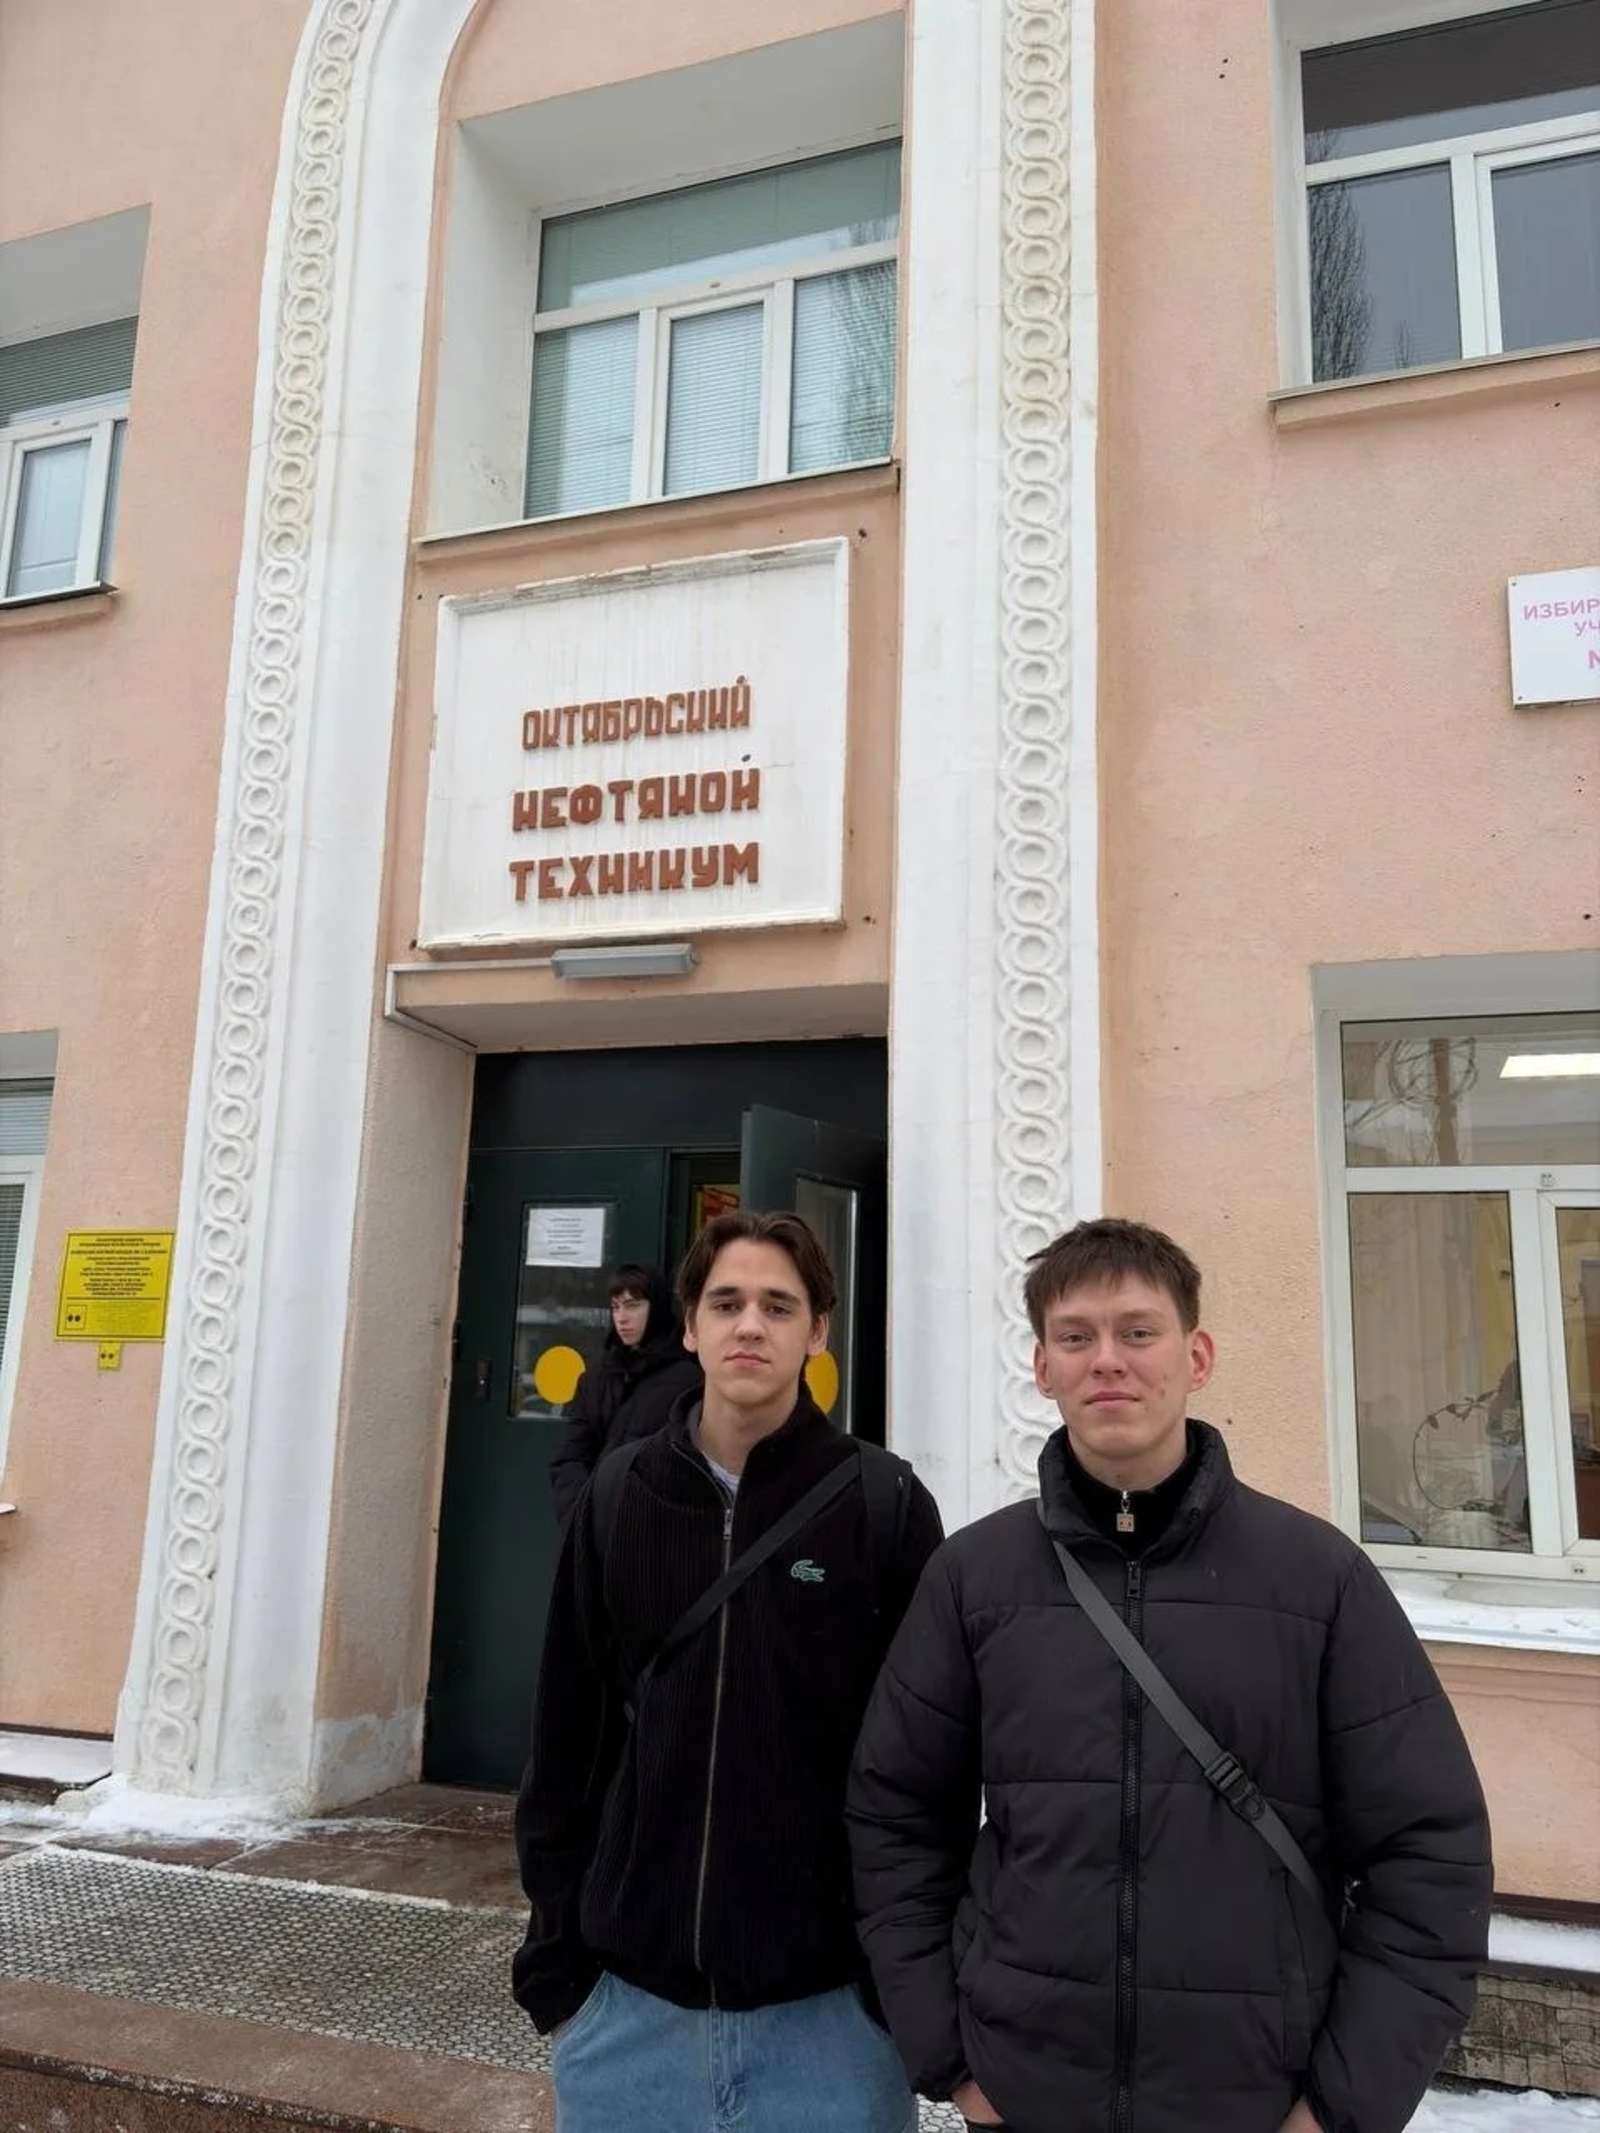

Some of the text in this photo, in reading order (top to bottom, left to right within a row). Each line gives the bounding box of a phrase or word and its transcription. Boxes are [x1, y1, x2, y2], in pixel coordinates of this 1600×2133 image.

[1523, 598, 1600, 620] ИЗБИР
[522, 675, 752, 751] ОКТЯБРЬСКИЙ
[512, 754, 760, 832] НЕФТЯНОЙ
[509, 842, 759, 901] ТЕХНИКУМ
